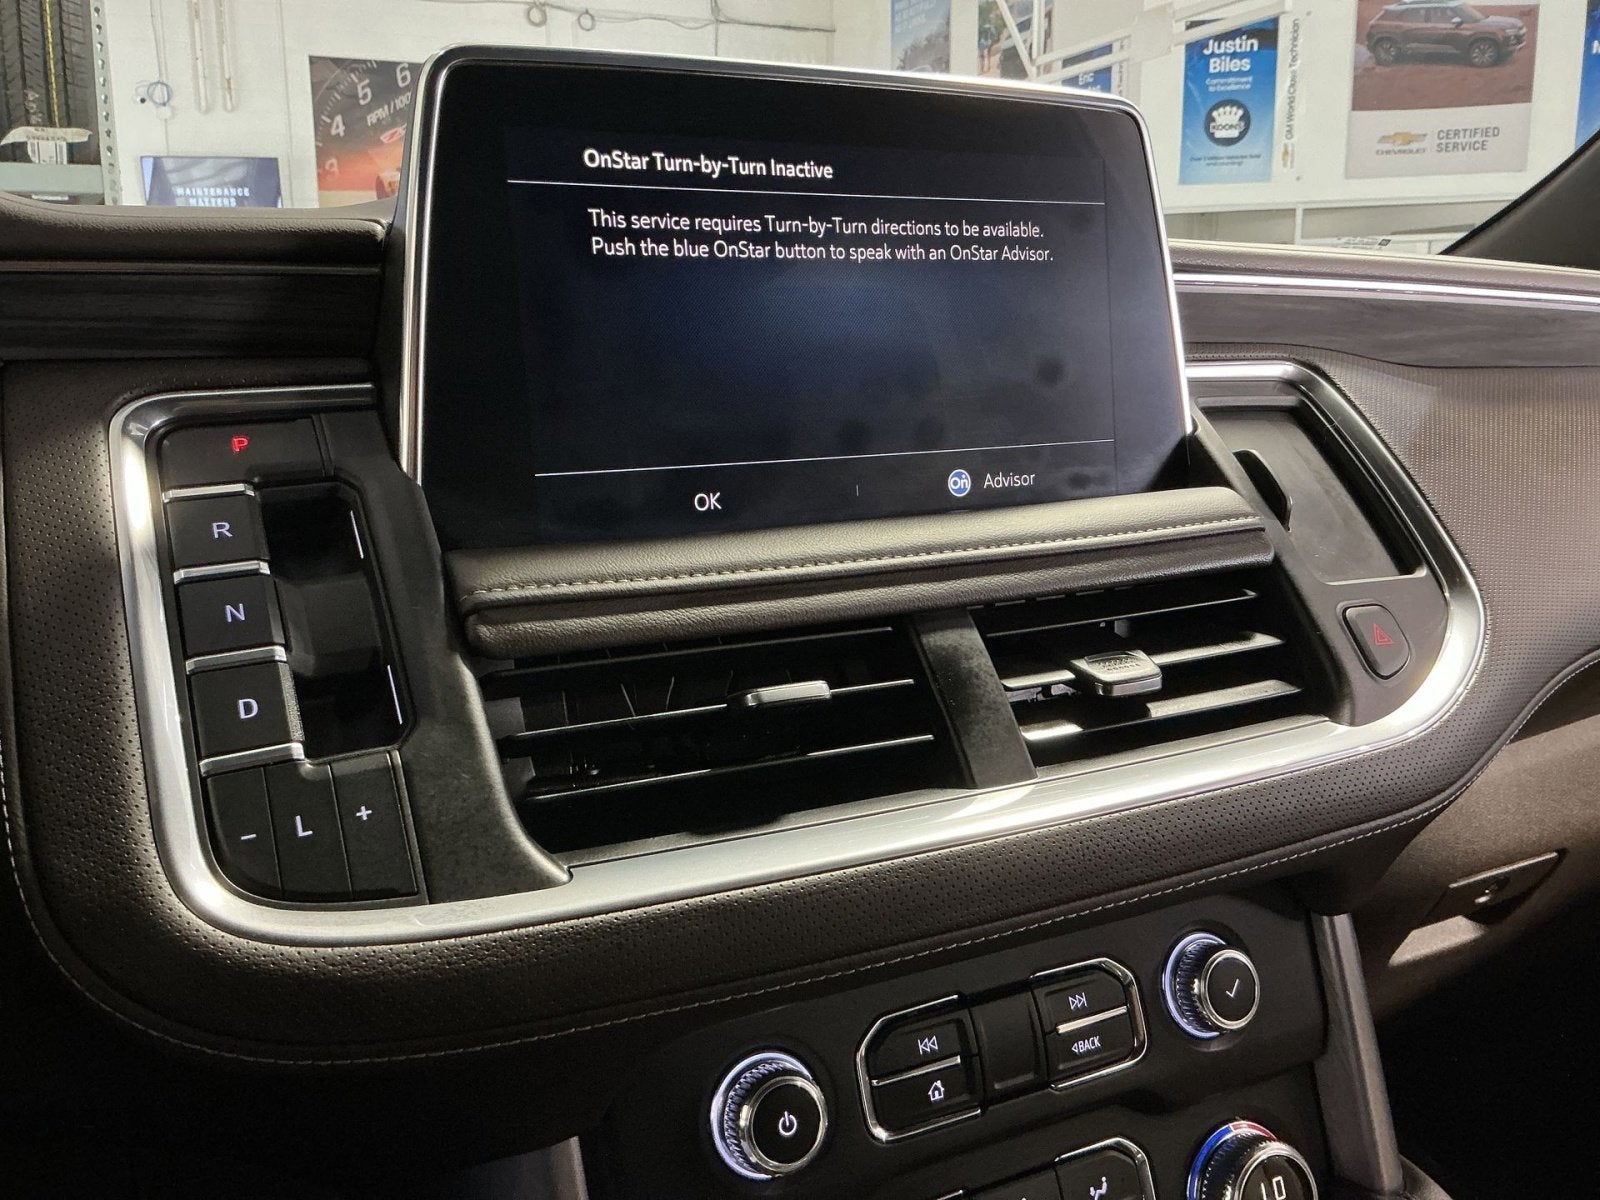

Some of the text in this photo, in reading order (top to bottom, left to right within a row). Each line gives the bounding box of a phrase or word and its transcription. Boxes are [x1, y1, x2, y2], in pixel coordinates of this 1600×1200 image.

[1203, 35, 1259, 56] Justin
[395, 62, 412, 88] 6
[1209, 57, 1251, 74] Biles
[356, 78, 373, 106] 5
[330, 114, 346, 138] 4
[1437, 127, 1501, 141] CERTIFIED
[1436, 140, 1488, 153] SERVICE
[583, 148, 834, 180] OnStar Turn-by-Turn Inactive
[587, 208, 1045, 239] This service requires Turn-by-Turn directions to be available.
[591, 236, 1054, 264] Push the blue OnStar button to speak with an OnStar Advisor.
[231, 435, 250, 456] P
[983, 471, 1036, 490] Advisor
[694, 491, 722, 512] OK
[211, 520, 234, 540] R
[224, 602, 247, 624] N
[236, 697, 260, 721] D
[295, 814, 314, 838] L
[1078, 1035, 1102, 1053] BACK
